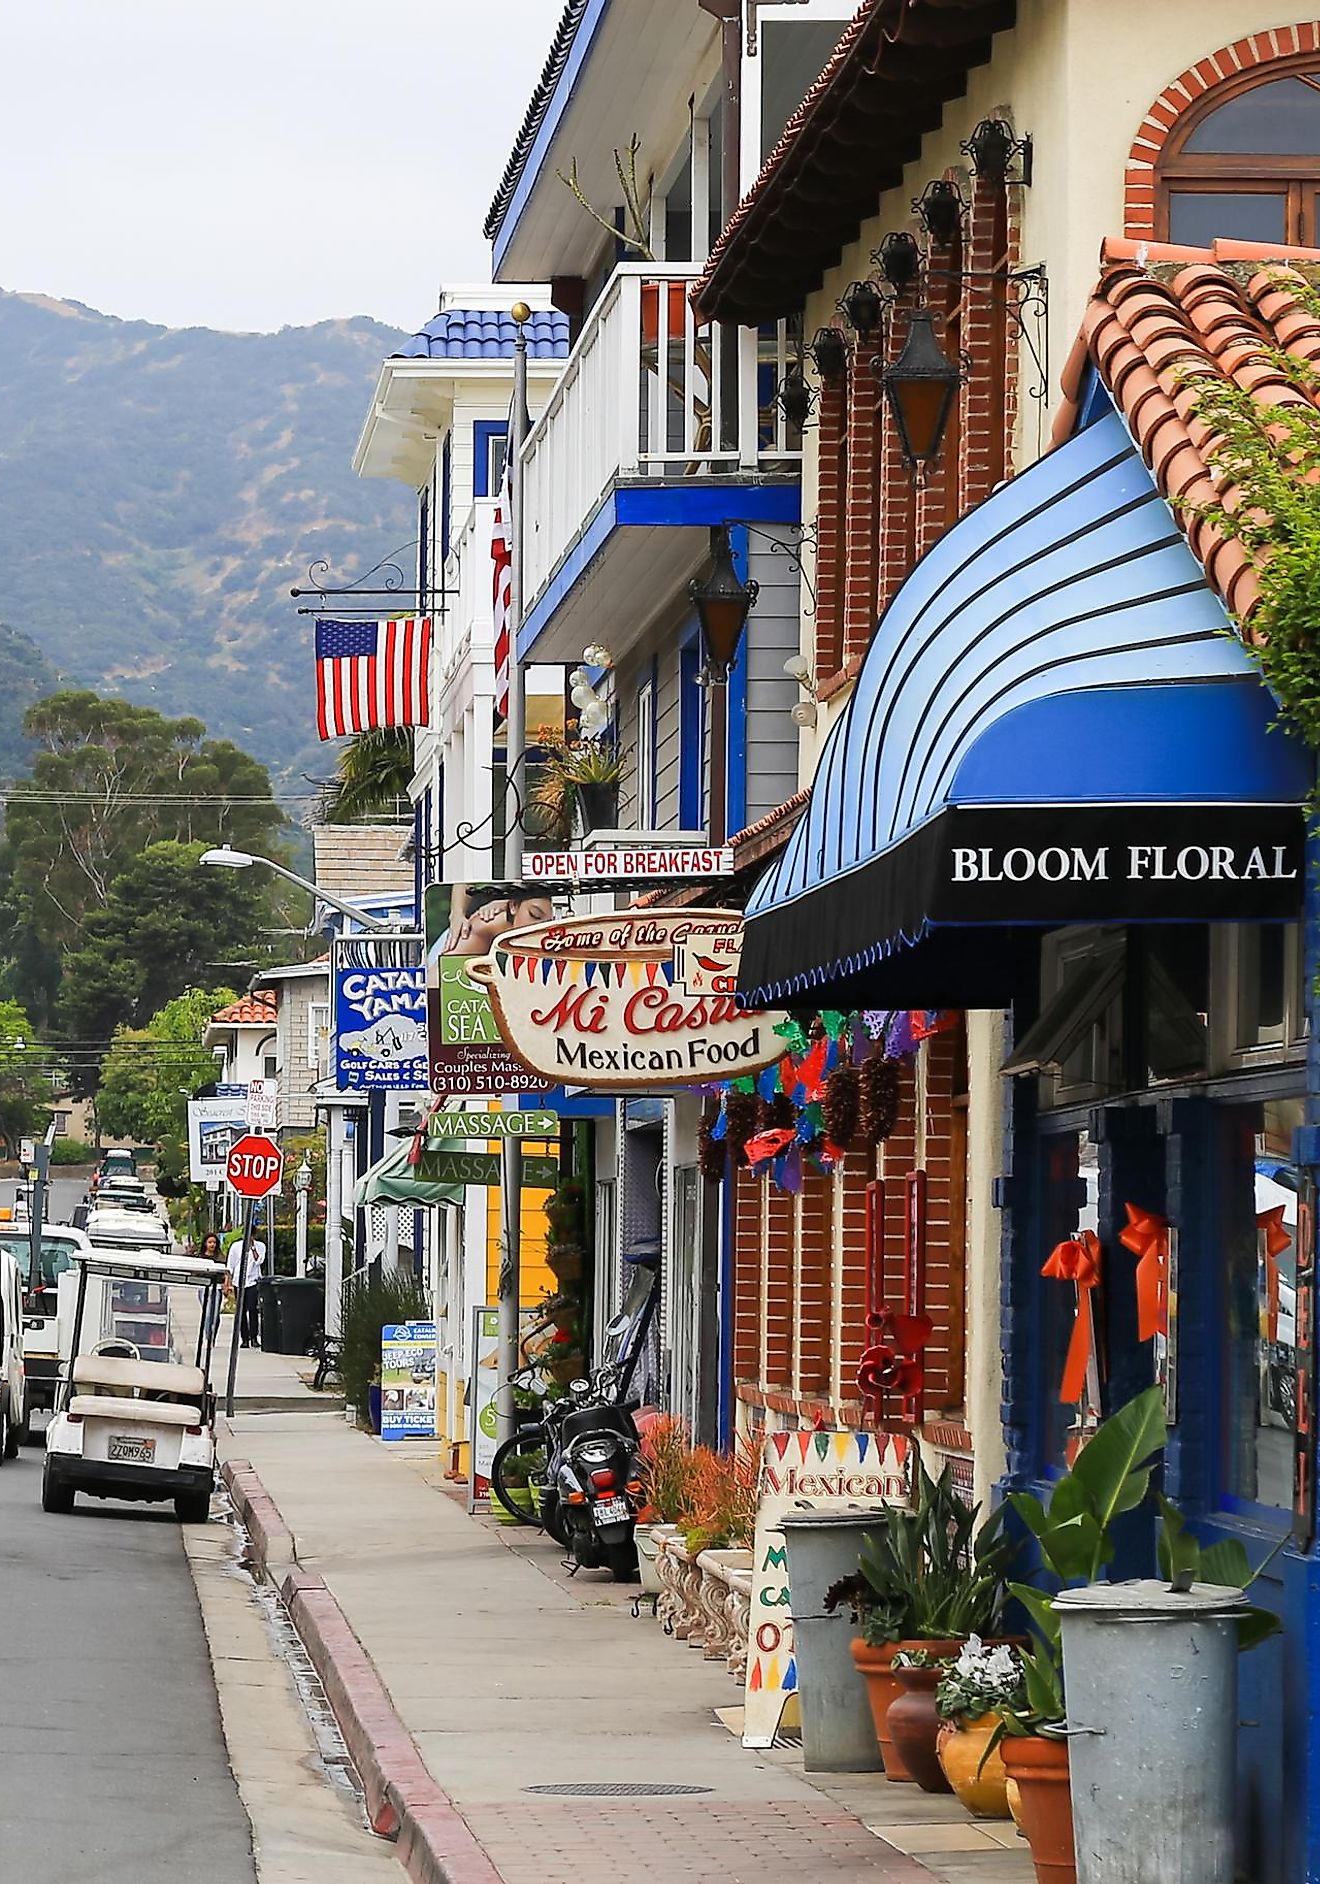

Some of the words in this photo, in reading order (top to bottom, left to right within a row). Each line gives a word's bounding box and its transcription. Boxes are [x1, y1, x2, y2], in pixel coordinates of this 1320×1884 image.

[532, 853, 578, 876] OPEN
[584, 852, 618, 875] FOR
[623, 850, 723, 874] BREAKFAST
[951, 846, 1109, 882] BLOOM
[1126, 845, 1298, 881] FLORAL
[541, 926, 602, 953] Home
[608, 922, 634, 948] of
[635, 920, 667, 944] the
[530, 983, 609, 1034] Mi
[448, 1014, 488, 1041] SEA
[456, 1045, 512, 1062] Specializing
[555, 1037, 681, 1071] Mexican
[687, 1027, 761, 1068] Food
[365, 1070, 400, 1081] SALES
[434, 1060, 488, 1076] Couples
[250, 1081, 263, 1093] NO
[433, 1075, 472, 1092] (310)
[433, 1113, 536, 1136] MASSAGE
[230, 1152, 279, 1179] STOP
[419, 1155, 535, 1182] MASSAE
[384, 1357, 415, 1369] TOURS
[382, 1415, 403, 1424] BUY
[761, 1465, 907, 1498] Mexican
